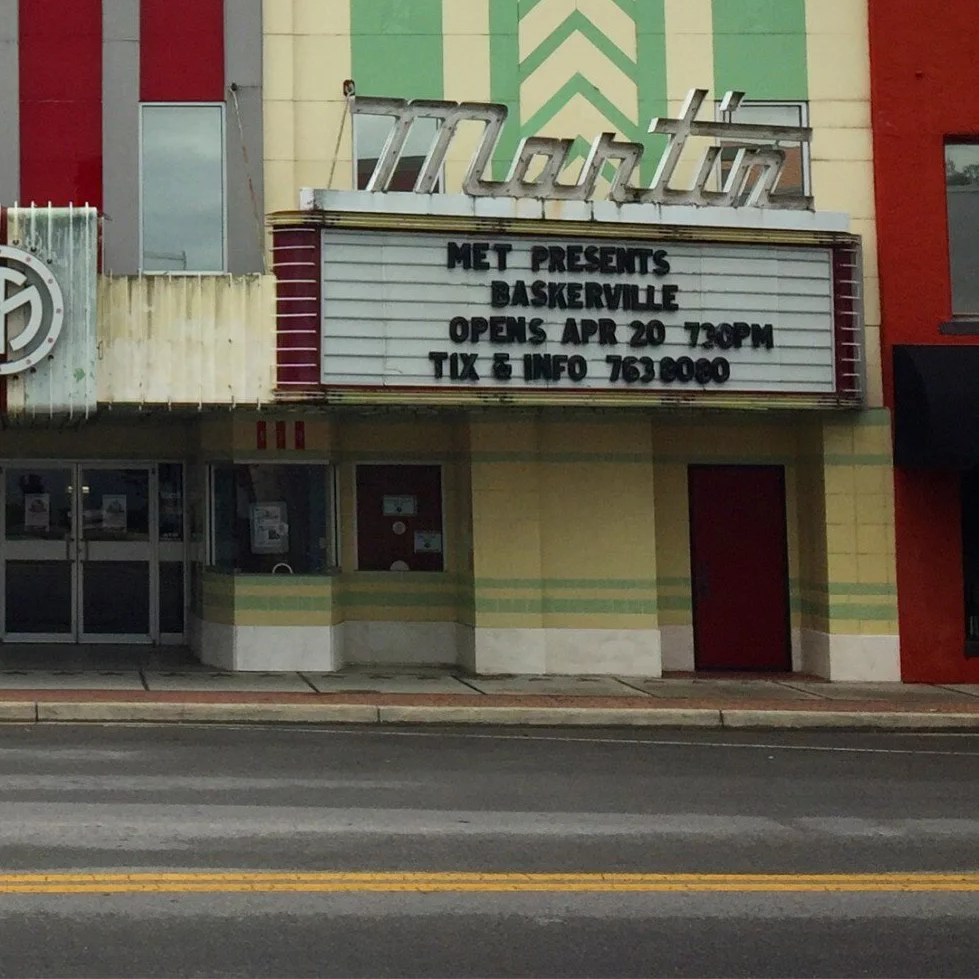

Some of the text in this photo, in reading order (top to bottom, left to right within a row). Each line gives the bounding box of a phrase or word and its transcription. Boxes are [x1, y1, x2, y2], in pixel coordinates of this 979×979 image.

[350, 88, 815, 212] Martin
[447, 242, 670, 276] MET PRESENTS
[491, 280, 679, 311] BASKERVILLE
[449, 317, 547, 344] OPENS
[561, 318, 618, 345] APR
[629, 320, 666, 347] 20
[429, 351, 480, 382] TIX
[492, 352, 513, 380] &
[523, 353, 588, 382] INFO
